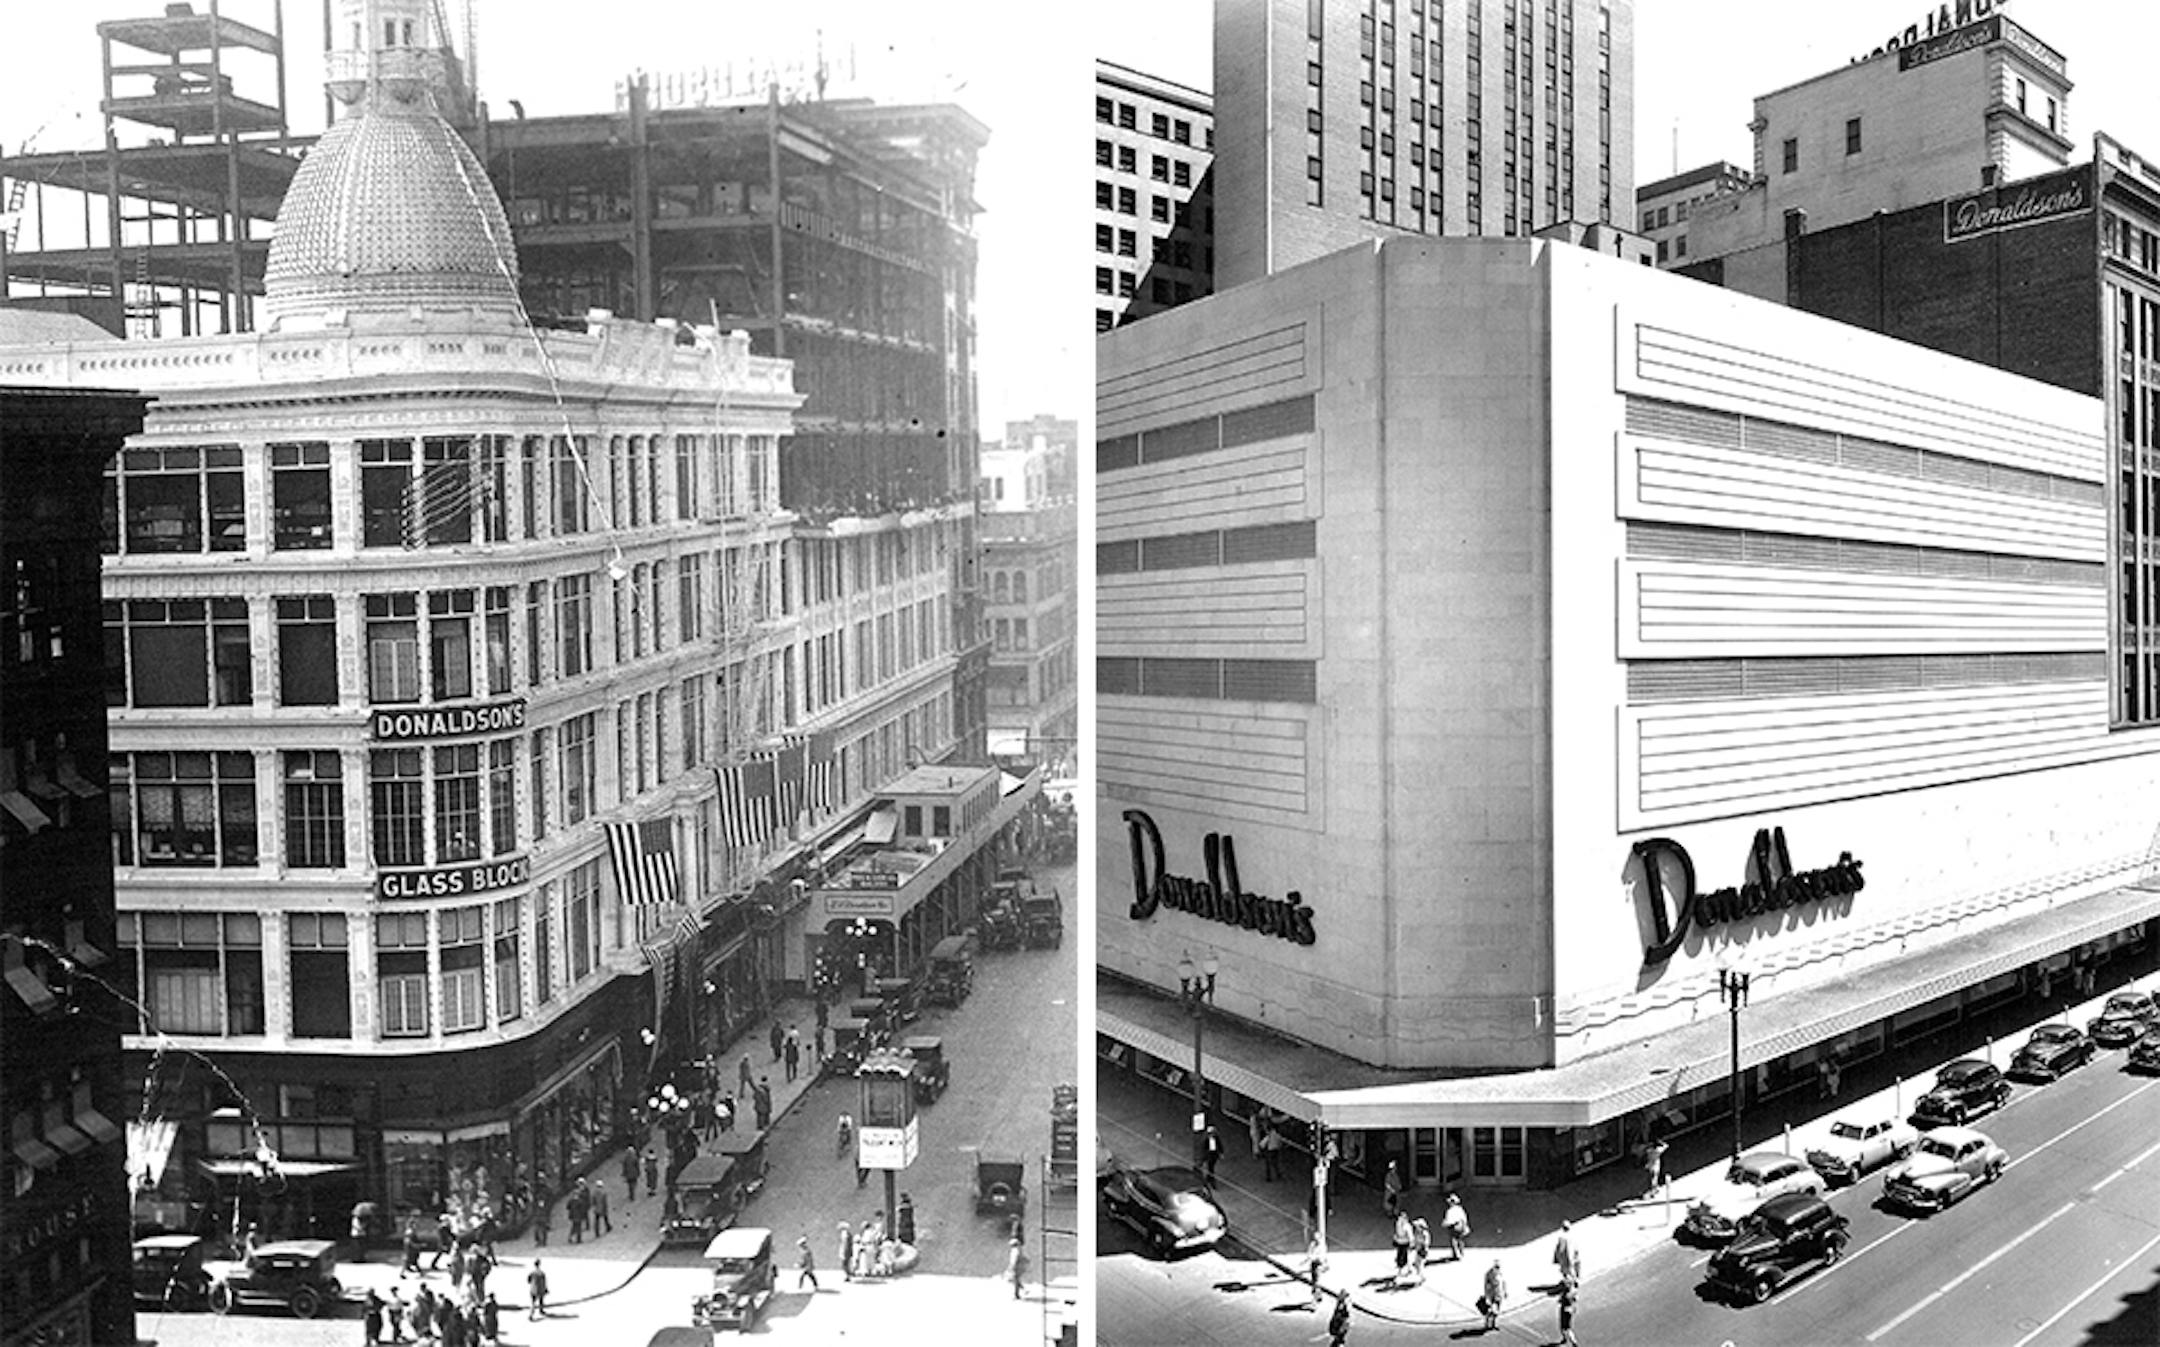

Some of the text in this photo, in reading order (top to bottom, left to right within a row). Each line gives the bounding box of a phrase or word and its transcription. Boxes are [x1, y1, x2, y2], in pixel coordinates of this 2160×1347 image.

[1952, 181, 2083, 233] Donaldson's
[377, 704, 523, 737] DONALDSON'S
[383, 858, 530, 897] GLASS BLOCK
[1122, 809, 1316, 946] Donaldson's
[1633, 826, 1865, 965] Donaldson's
